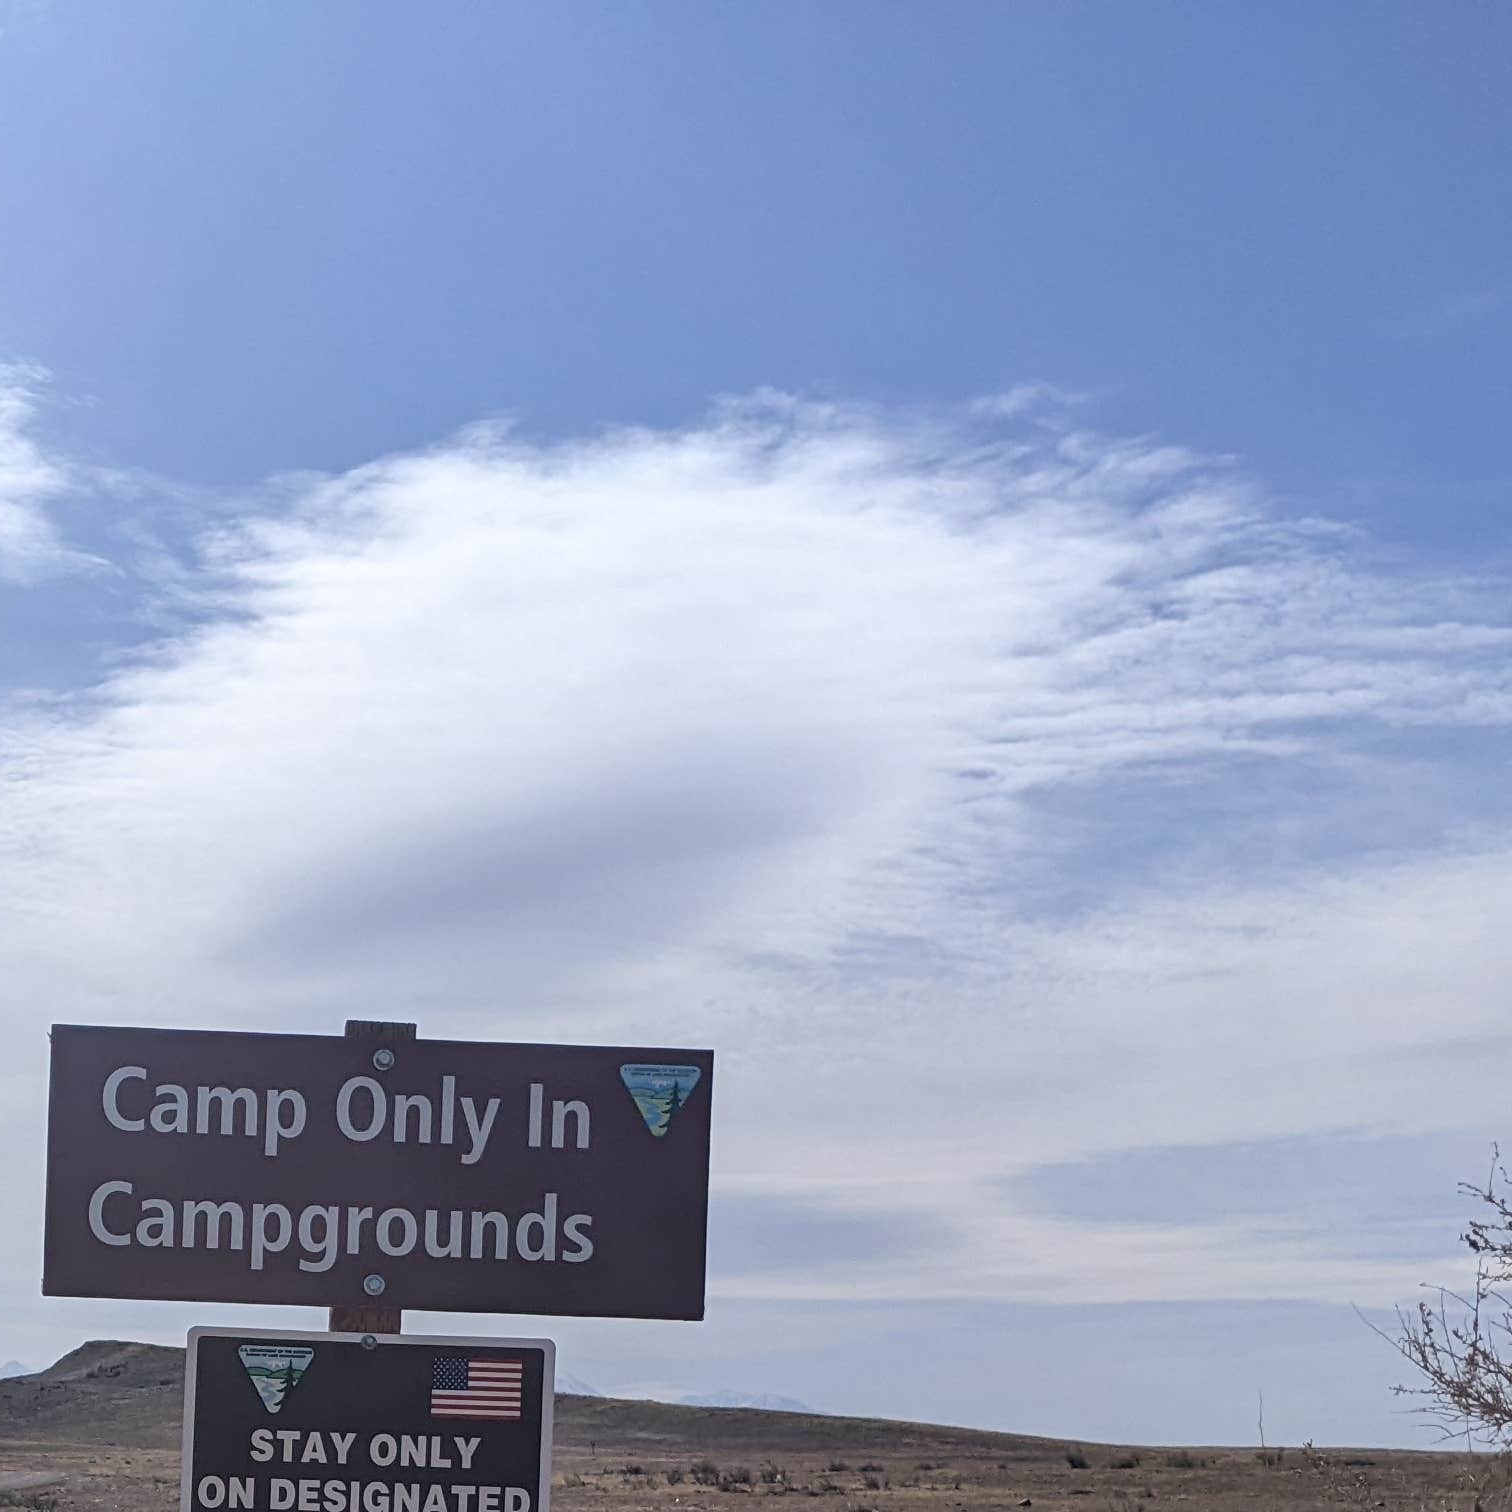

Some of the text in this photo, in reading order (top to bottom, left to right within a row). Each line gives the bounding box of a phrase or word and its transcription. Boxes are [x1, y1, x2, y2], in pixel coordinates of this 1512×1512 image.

[102, 1066, 590, 1165] Camp Only In
[88, 1181, 594, 1273] Campgrounds
[250, 1429, 481, 1469] STAY ONLY
[197, 1476, 255, 1510] ON
